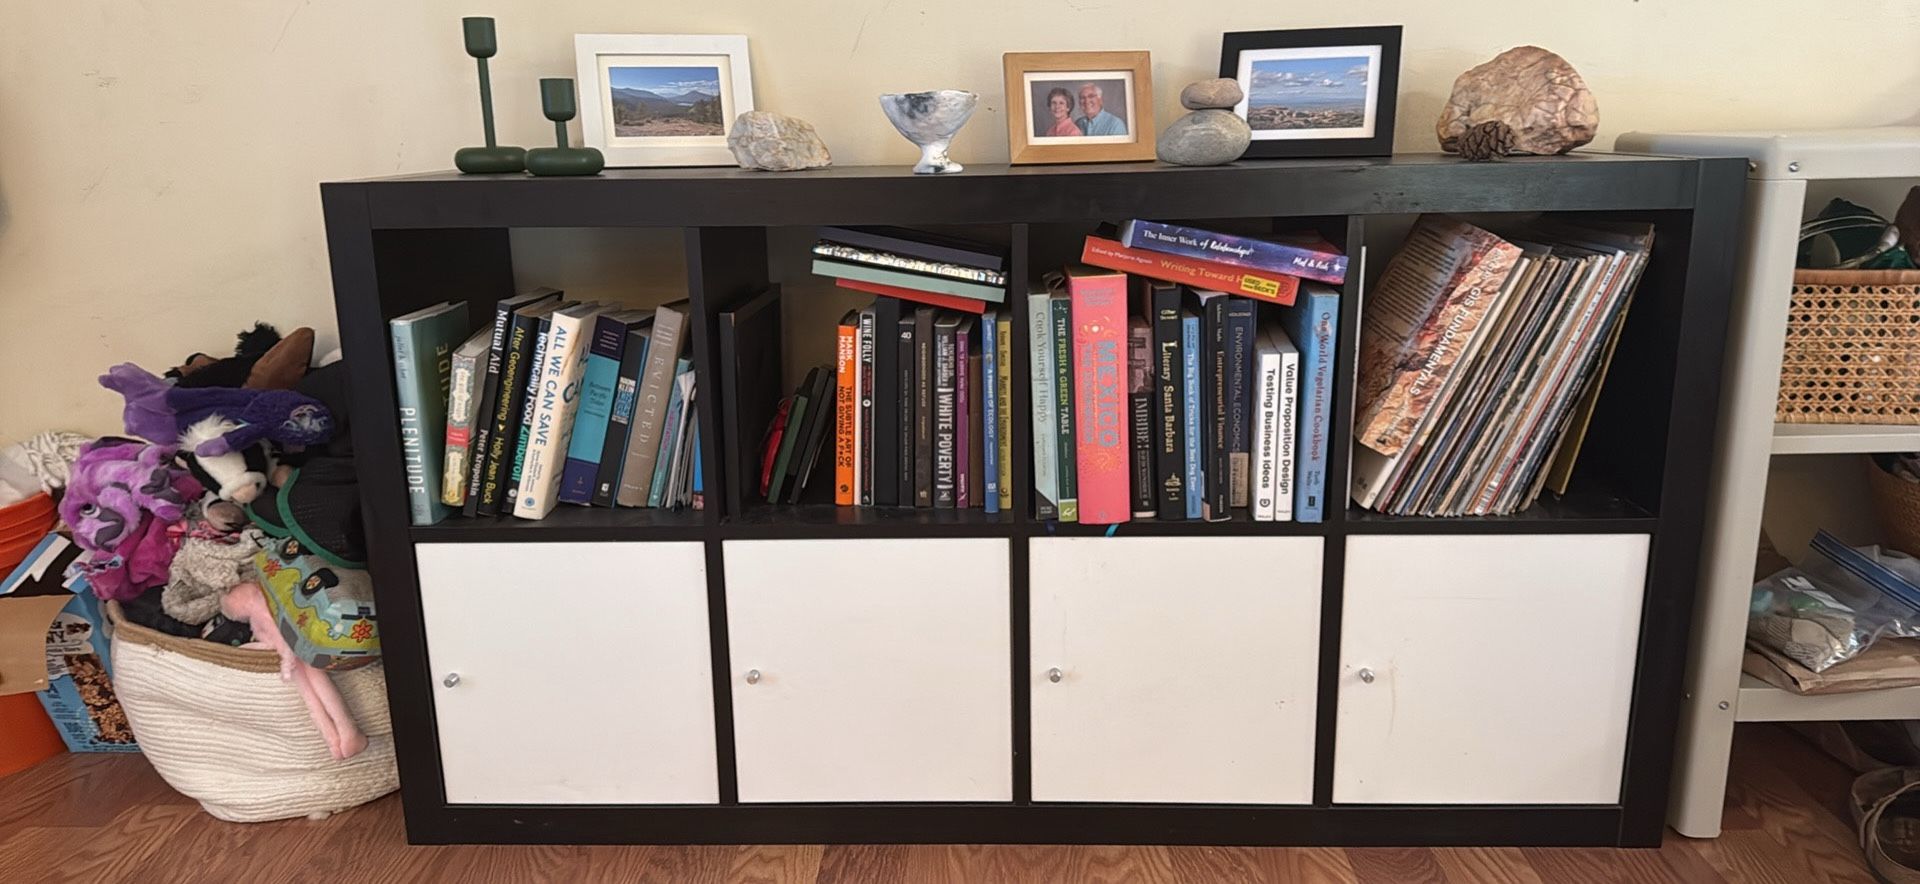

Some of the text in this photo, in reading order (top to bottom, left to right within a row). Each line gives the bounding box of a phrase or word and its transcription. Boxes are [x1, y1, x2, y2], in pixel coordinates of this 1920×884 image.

[1091, 246, 1109, 256] Edited
[1143, 229, 1158, 240] The
[1158, 233, 1178, 244] Inner
[1178, 236, 1198, 247] Work
[1199, 239, 1210, 251] of
[1160, 259, 1198, 277] Writing
[1198, 265, 1235, 283] Toward
[1465, 286, 1483, 308] GIS
[488, 309, 509, 374] Mutual Aid
[552, 325, 568, 350] ALL
[862, 317, 872, 339] WINE
[1035, 311, 1046, 339] Cook
[1057, 317, 1066, 338] THE
[526, 331, 549, 396] Technically
[838, 335, 846, 374] MANSON
[845, 335, 853, 361] MARK
[862, 339, 872, 363] FOLLY
[1036, 341, 1049, 386] Yourself
[1058, 338, 1067, 367] FRESH
[1232, 326, 1244, 401] ENVIRONMENTAL
[1409, 306, 1468, 396] FUNDAMENTALS
[497, 326, 525, 421] After Geoengineering
[547, 355, 563, 379] WE
[1215, 350, 1225, 416] Entrepreneurial
[1284, 363, 1295, 394] Value
[541, 380, 558, 411] CAN
[638, 356, 665, 444] EVICTED
[838, 385, 846, 402] NOT
[987, 399, 994, 408] OF
[1059, 375, 1068, 405] GREEN
[1096, 340, 1118, 448] MEXICO
[1161, 341, 1178, 454] Literary Santa Barbara
[1310, 311, 1331, 462] One World Vegetarian Cookbook
[522, 395, 537, 425] Food
[838, 404, 846, 433] GIVING
[986, 408, 994, 438] ECOLOGY
[1037, 388, 1050, 424] Happy
[1060, 407, 1070, 435] TABLE
[1134, 397, 1150, 449] IMBIBE!
[1187, 353, 1197, 492] The Big Book of Tricks for the Best Dog Ever
[534, 413, 552, 447] SAVE
[838, 436, 846, 444] A
[845, 385, 853, 468] THE SUBTLE ART OF
[937, 392, 954, 484] WHITE POVERTY
[1216, 416, 1225, 449] Finance
[1231, 402, 1241, 453] ECONOMICS
[1262, 368, 1276, 489] Testing Business Ideas
[1280, 396, 1294, 457] Proposition
[399, 407, 425, 494] PLENITUDE
[469, 428, 488, 497] Peter Kropotkin
[482, 436, 504, 505] Holly Jean Buck
[1279, 459, 1292, 495] Design
